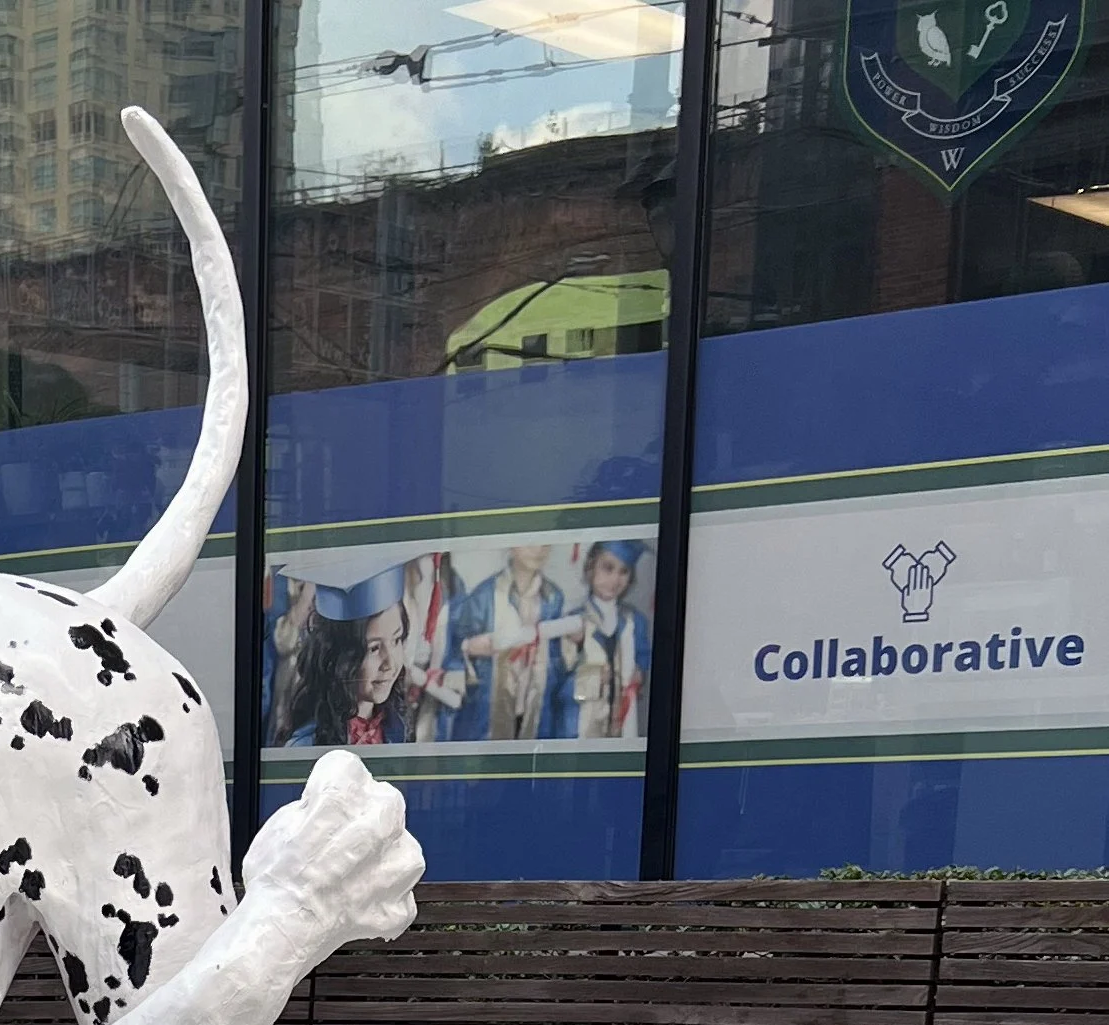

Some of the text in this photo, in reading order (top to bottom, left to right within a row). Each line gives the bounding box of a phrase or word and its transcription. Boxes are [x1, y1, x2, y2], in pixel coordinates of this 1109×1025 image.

[1008, 31, 1057, 87] SUCCESS
[872, 72, 907, 106] POWER
[929, 115, 981, 134] WISDOM
[940, 147, 966, 172] W
[754, 627, 1085, 682] Collaborative
